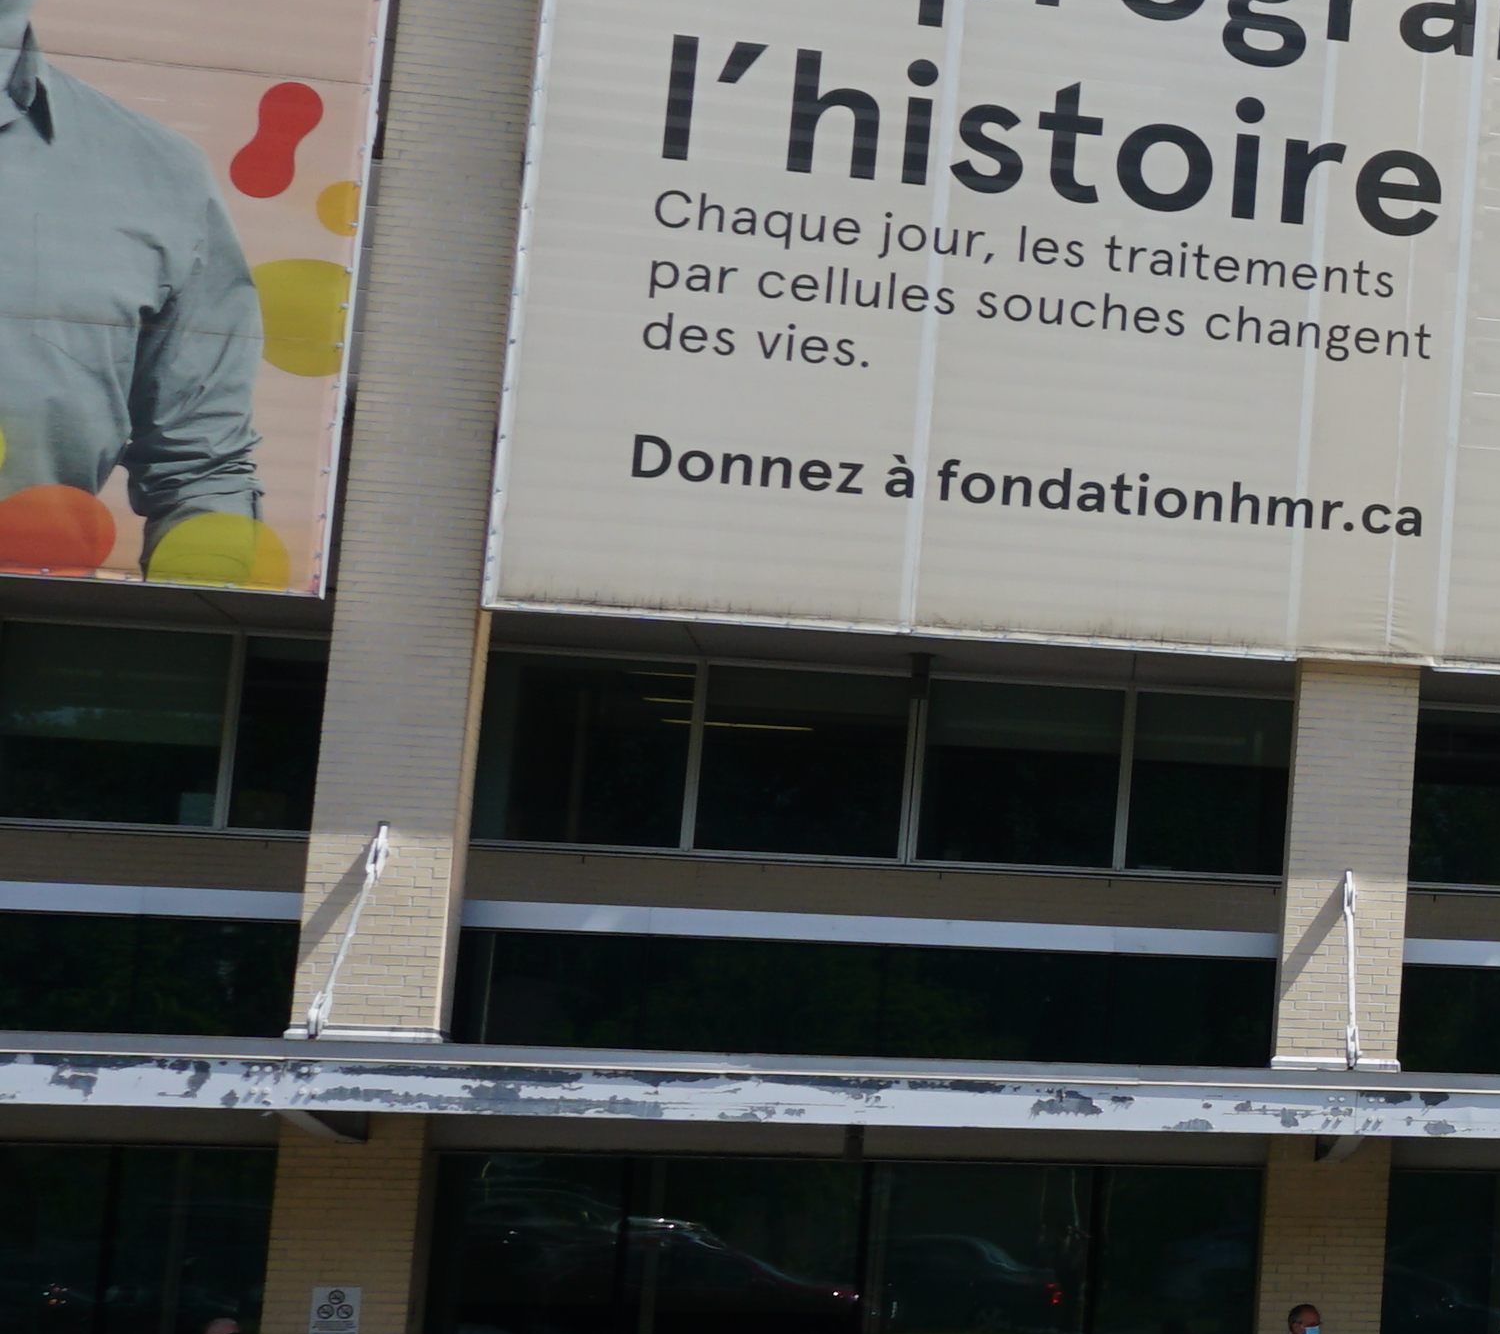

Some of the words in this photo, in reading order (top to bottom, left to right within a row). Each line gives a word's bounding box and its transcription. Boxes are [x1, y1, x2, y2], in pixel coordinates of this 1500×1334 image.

[661, 33, 1443, 238] l'histoire
[653, 189, 862, 251] Chaque
[878, 210, 996, 265] jour,
[1017, 224, 1087, 270] les
[1104, 233, 1396, 300] traitements
[641, 312, 736, 357] des
[756, 326, 871, 369] vies.
[648, 258, 738, 299] par
[756, 265, 957, 317] cellules
[975, 287, 1187, 338] souches
[1204, 302, 1432, 362] changent
[630, 433, 864, 496] Donnez
[884, 453, 916, 500] à
[936, 458, 1425, 538] fondationhmr.ca
